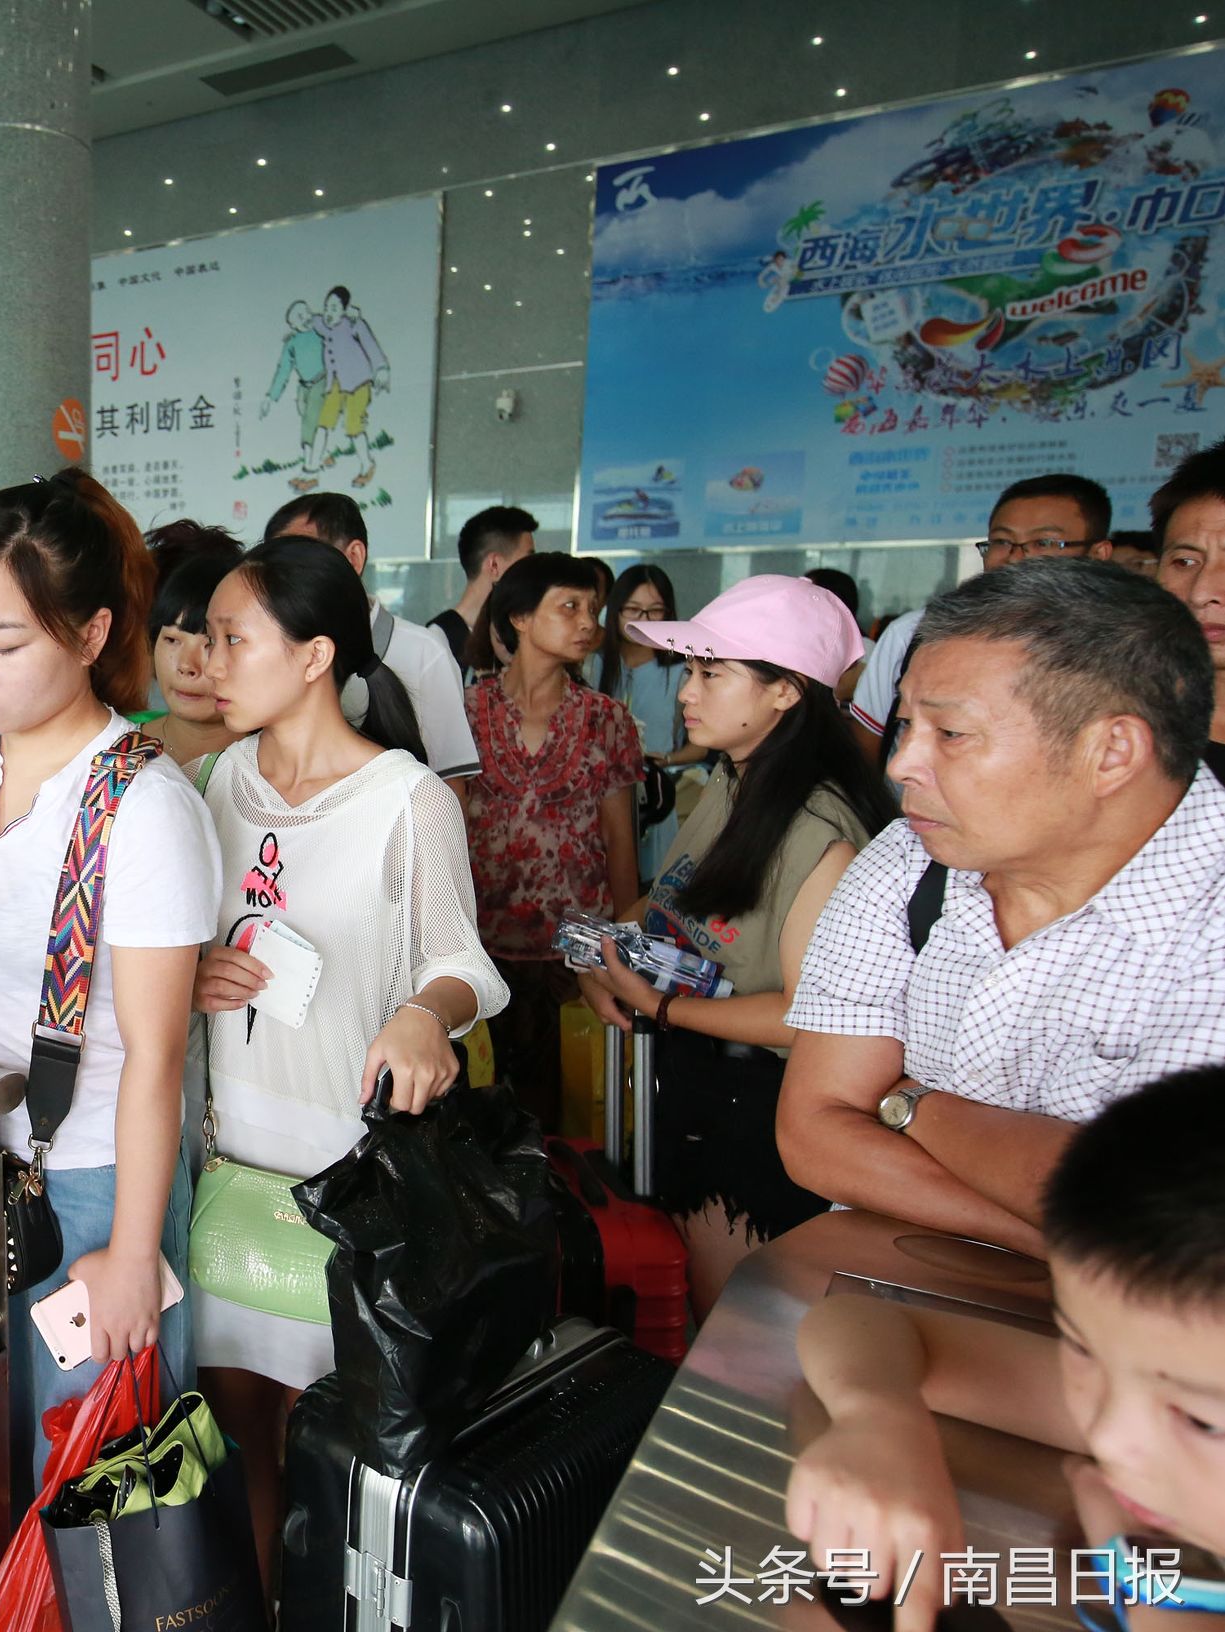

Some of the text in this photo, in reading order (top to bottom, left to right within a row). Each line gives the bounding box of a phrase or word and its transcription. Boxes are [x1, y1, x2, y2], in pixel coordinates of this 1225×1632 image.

[1009, 268, 1149, 317] welcome
[95, 394, 216, 439] 其利断金
